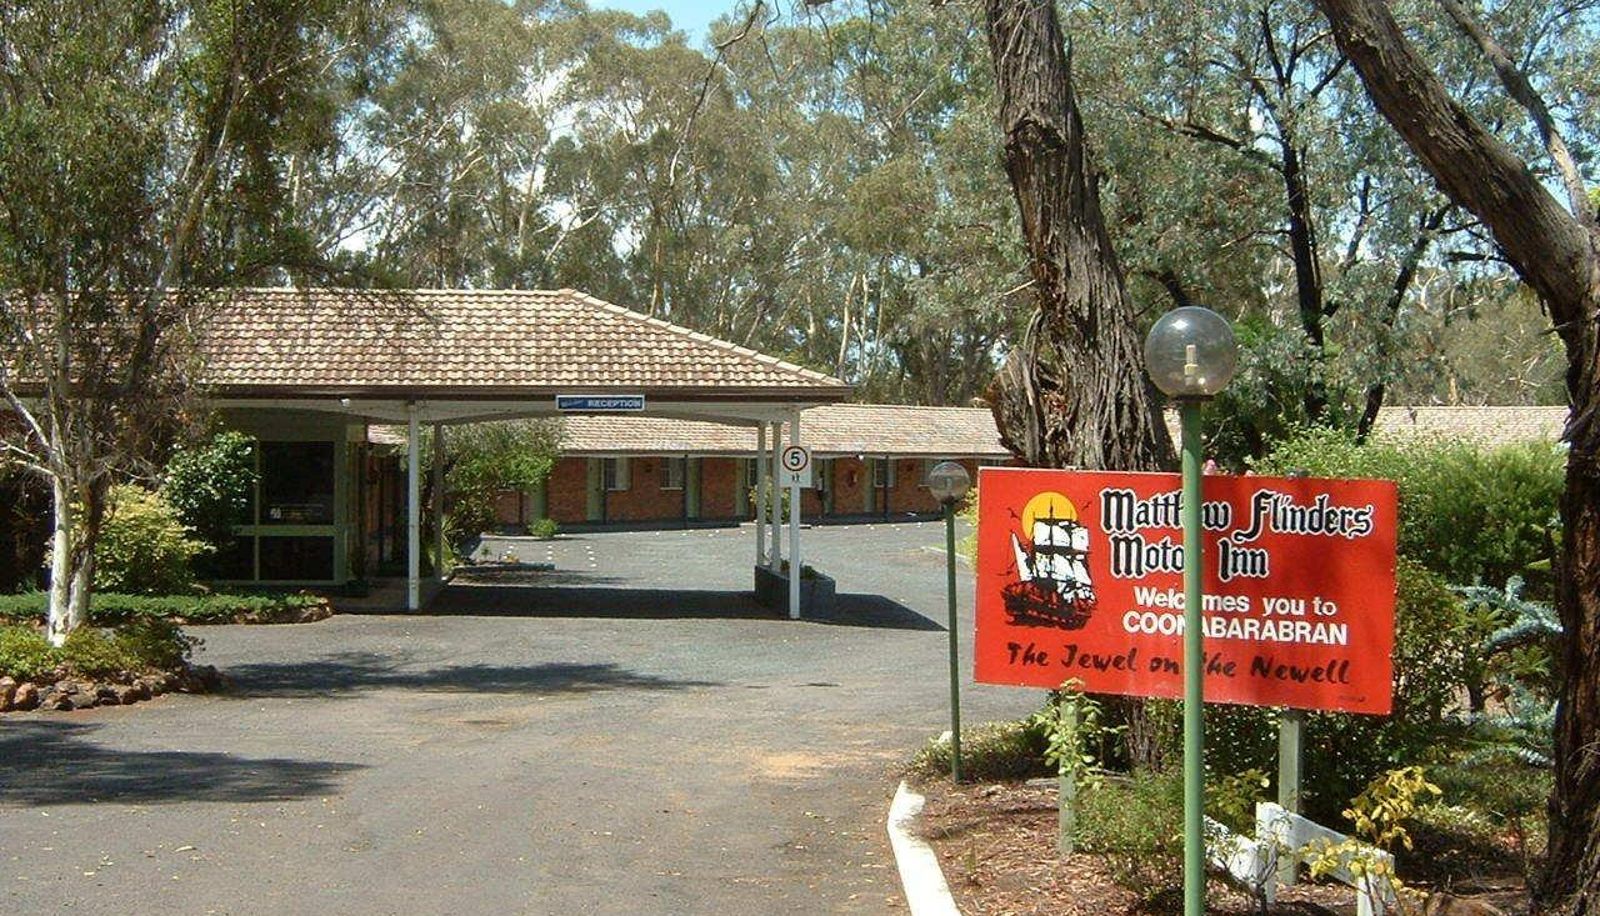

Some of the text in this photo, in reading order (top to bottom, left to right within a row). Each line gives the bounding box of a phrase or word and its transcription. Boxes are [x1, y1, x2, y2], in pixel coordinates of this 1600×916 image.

[587, 399, 641, 409] RECEPTION
[790, 451, 800, 467] 5
[1100, 488, 1373, 543] Matthw Flinders
[1110, 533, 1269, 582] Moto Inn
[1133, 586, 1338, 617] Welcmes you to
[1007, 642, 1049, 666] The
[1061, 644, 1137, 672] Jewel
[1149, 657, 1180, 675] on
[1250, 655, 1350, 684] Newell
